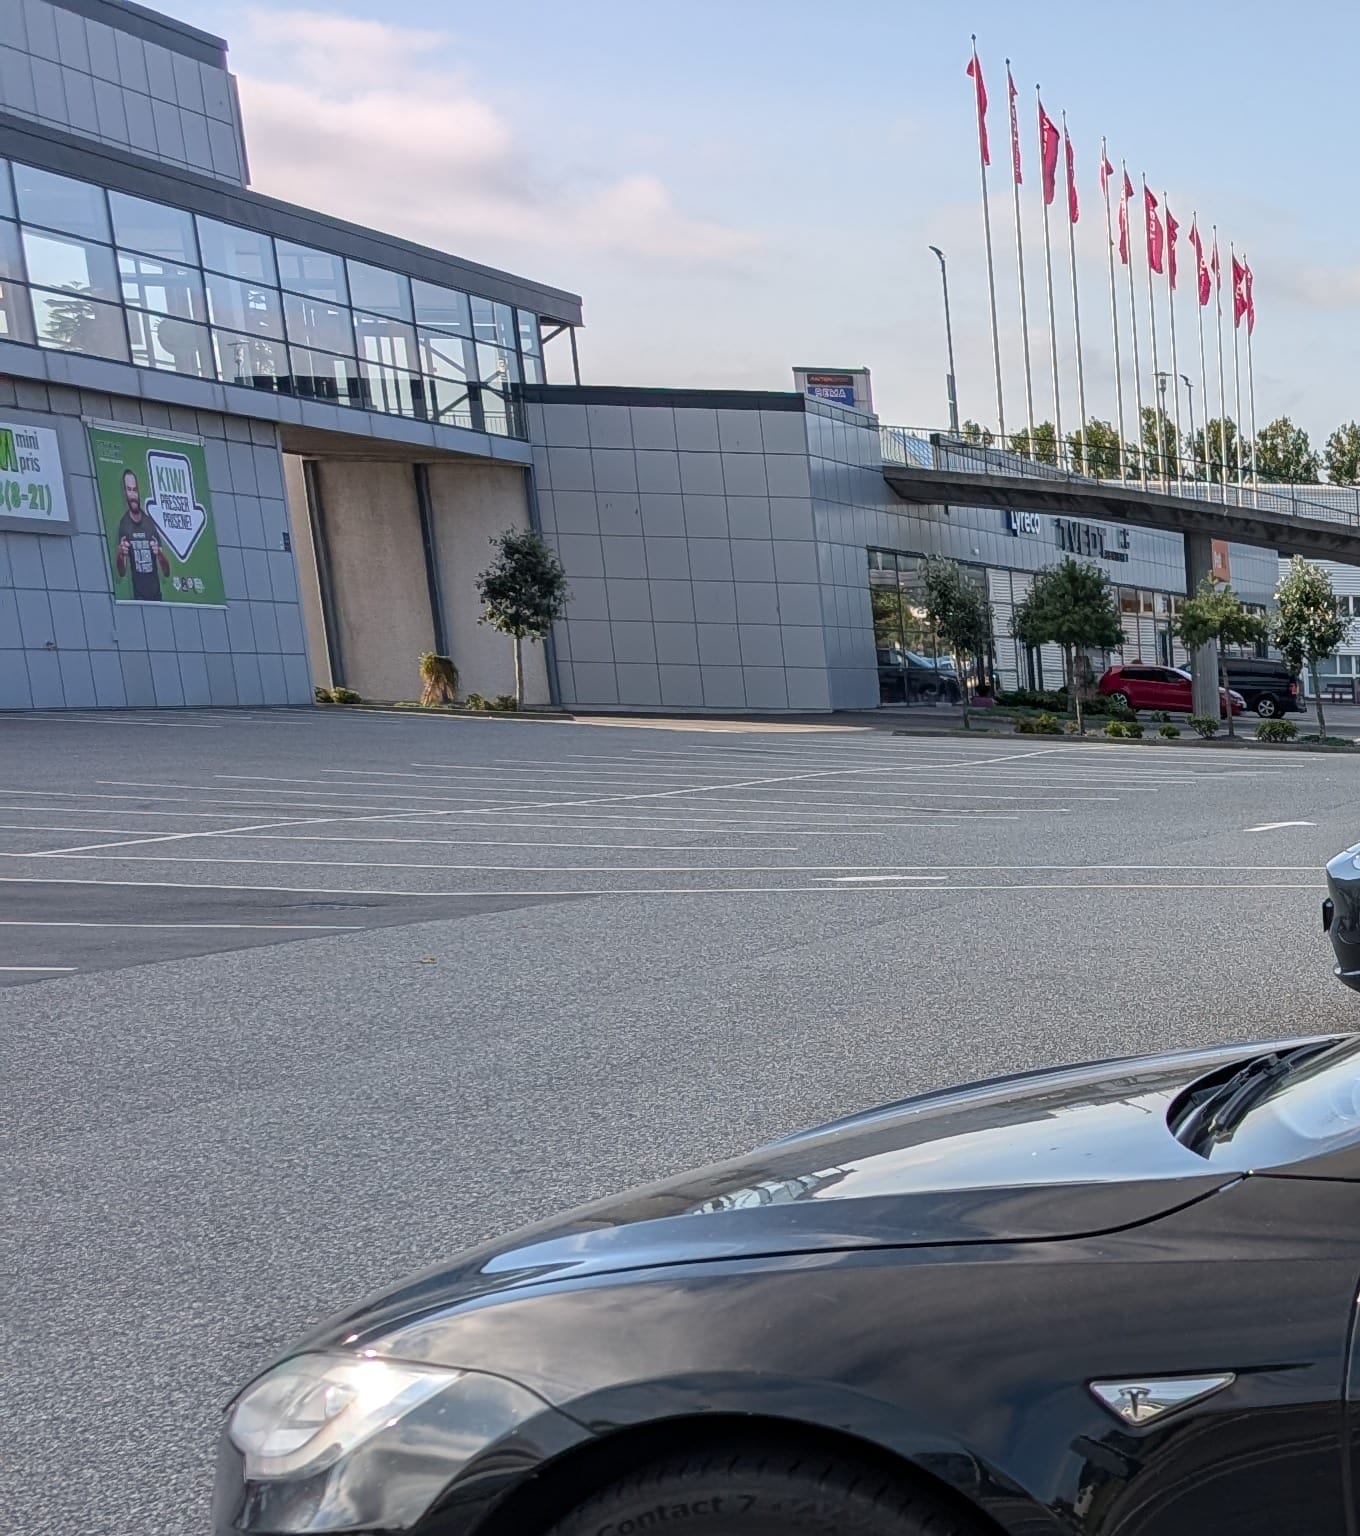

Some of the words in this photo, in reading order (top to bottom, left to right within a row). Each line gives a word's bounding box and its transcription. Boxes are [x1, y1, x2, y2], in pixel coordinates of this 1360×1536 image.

[15, 429, 40, 450] mini
[19, 452, 41, 475] pris
[155, 465, 188, 495] KIWI
[160, 494, 191, 513] PRESSER
[1010, 509, 1041, 537] Lyreco
[737, 1494, 758, 1514] 7
